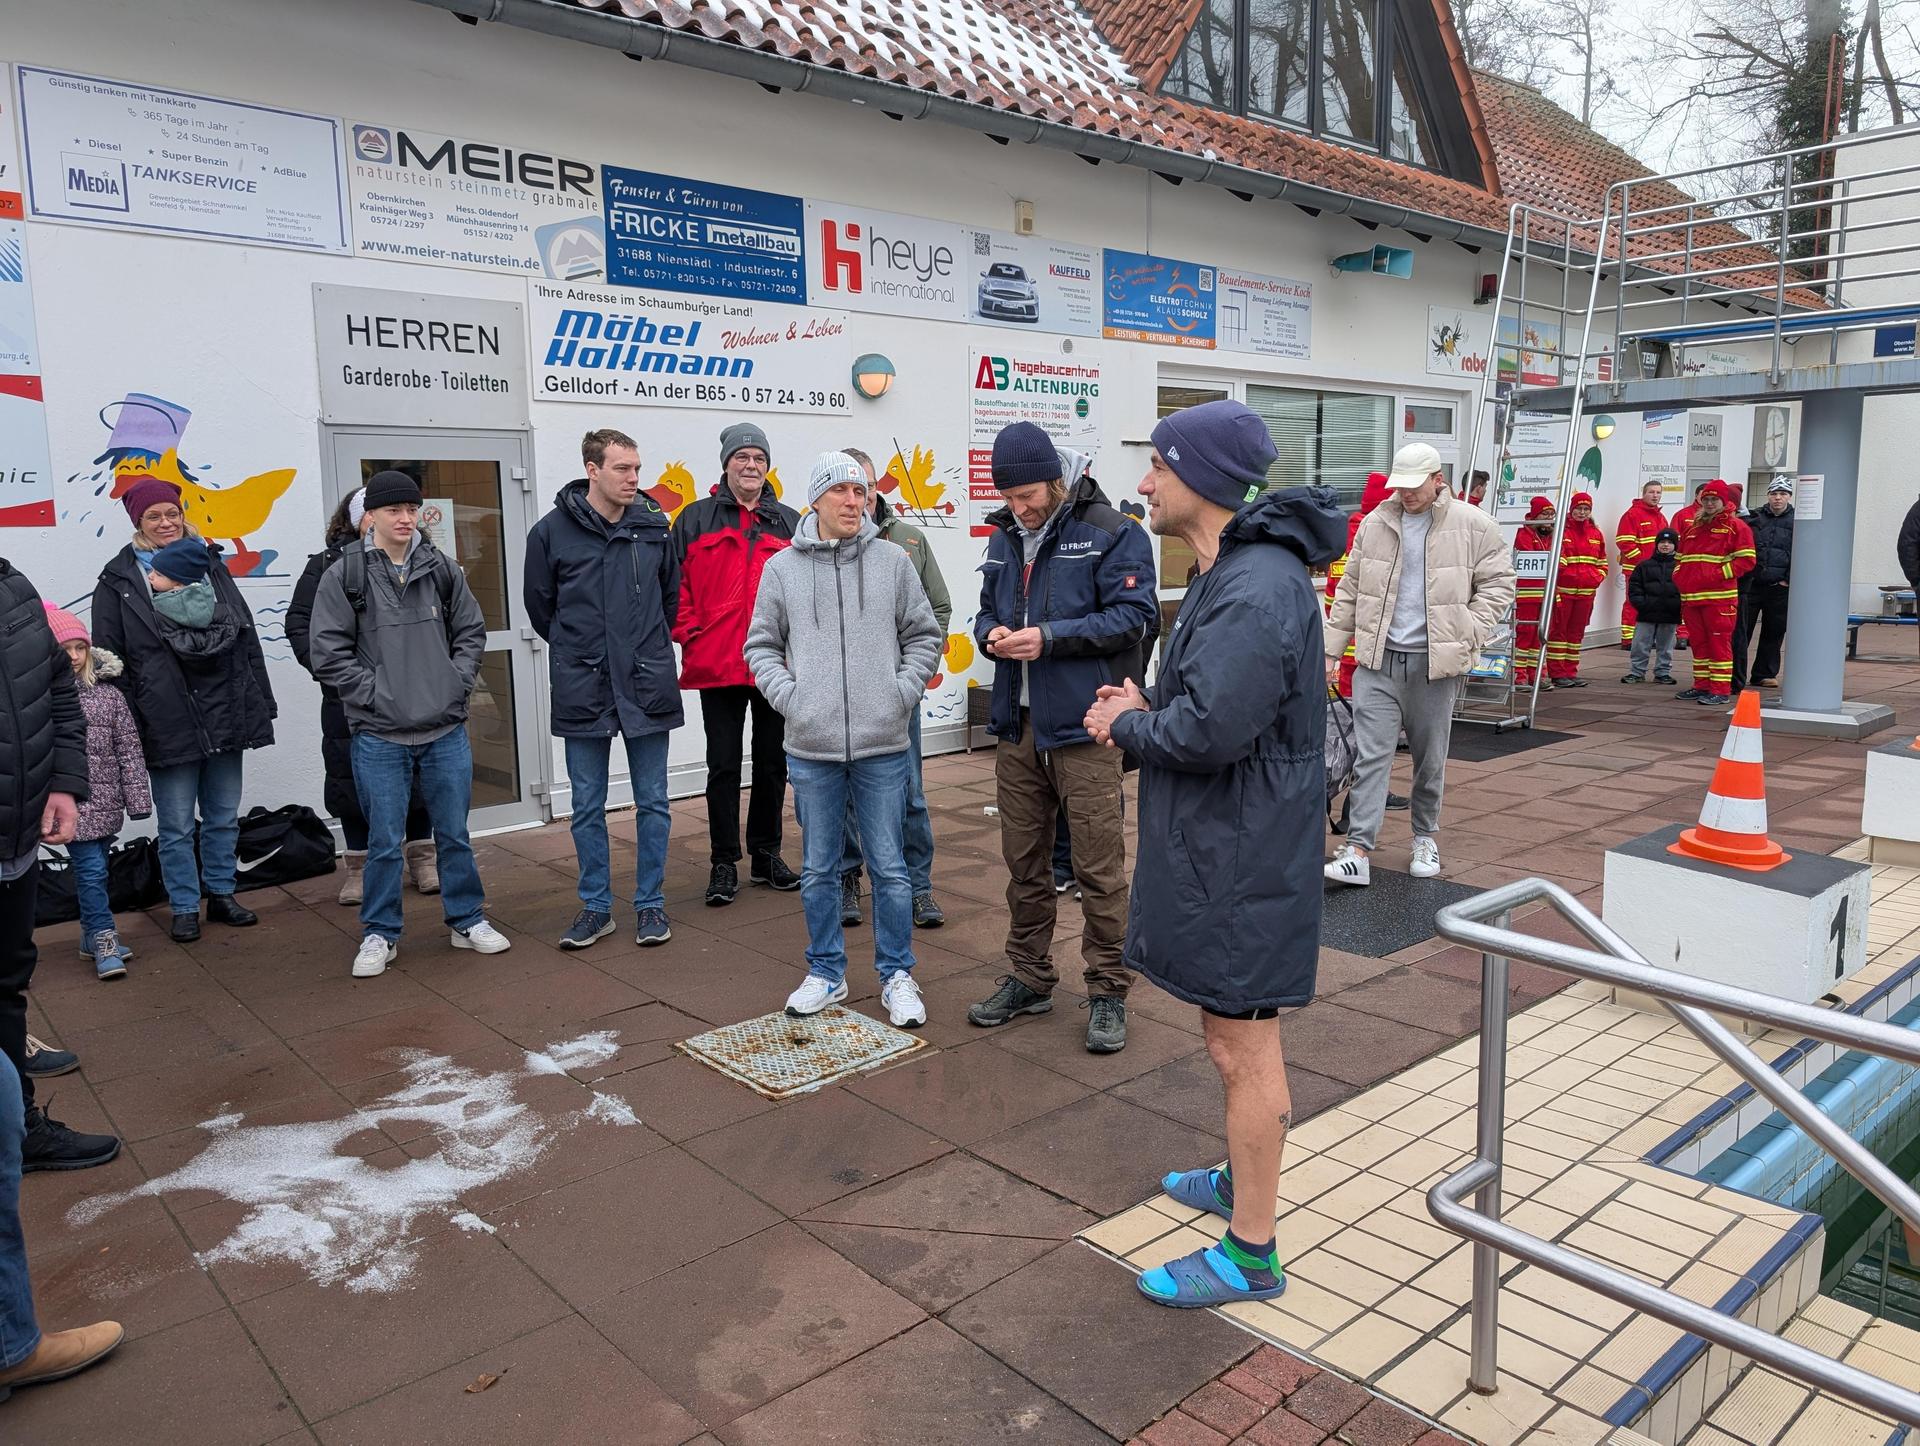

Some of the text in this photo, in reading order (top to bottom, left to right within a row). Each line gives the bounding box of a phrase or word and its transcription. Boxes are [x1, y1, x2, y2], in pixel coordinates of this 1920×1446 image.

[49, 77, 197, 110] Günstig tanken mit Tankkarte
[143, 110, 228, 132] 365 Tage im Jahr
[88, 138, 122, 151] Diesel
[176, 131, 269, 155] 24 Stunden am Tag
[161, 149, 229, 167] Super Benzin
[396, 131, 595, 197] MEIER
[131, 164, 258, 194] TANKSERVICE
[273, 166, 307, 179] AdBlue
[149, 193, 200, 205] Gewerbegebiet
[356, 165, 599, 211] naturstein steinmetz grabmale
[367, 191, 426, 207] Obernkirchen
[609, 178, 661, 200] Fenster
[665, 188, 677, 203] &
[682, 189, 719, 208] Türen
[722, 201, 744, 213] von
[149, 201, 178, 210] Kleefeld
[360, 202, 434, 221] Krainhäger Weg 3
[456, 204, 519, 220] Hess. Oldendorf
[370, 216, 398, 226] 05724
[404, 220, 425, 230] 2297
[446, 214, 529, 232] Münchhausenring 14
[609, 208, 796, 252] FRICKE metallbau
[463, 228, 488, 238] 05152
[494, 232, 514, 242] 4202
[362, 240, 540, 270] www.meier-naturstein.de
[617, 247, 798, 279] 31688 Nienstädt Industriestr. 6
[869, 226, 953, 282] heye
[622, 265, 641, 277] Tel.
[740, 280, 796, 295] 05721-72409
[1049, 263, 1091, 278] KAUFFELD
[870, 276, 955, 303] international
[1218, 272, 1311, 298] Bauelemente-Service Koch
[538, 285, 753, 318] Ihre Adresse im Schaumburger Land!
[1150, 294, 1213, 310] ELEKTROTECHNIK
[346, 313, 500, 356] HERREN
[554, 308, 702, 347] Möbel
[721, 318, 843, 350] Wohnen & Leben
[1114, 329, 1210, 347] LEISTUNG VERTRAUEN SICHERHEIT
[343, 364, 509, 393] Garderobe Toiletten
[1013, 358, 1100, 379] hagebaucentrum
[544, 375, 619, 395] Gelldorf
[634, 380, 658, 398] An
[662, 382, 690, 400] der
[695, 384, 726, 401] B65
[741, 387, 750, 403] 0
[755, 388, 772, 404] 57
[777, 389, 795, 405] 24
[808, 391, 825, 407] 39
[829, 392, 846, 408] 60
[1013, 377, 1100, 397] ALTENBURG
[974, 398, 1019, 409] Baustoffhandel
[1020, 401, 1030, 409] Tel.
[1031, 402, 1047, 410] 05721
[974, 408, 1017, 417] hagebaumarkt
[1021, 410, 1031, 418] Tel.
[1031, 411, 1047, 419] 05721
[1693, 423, 1718, 437] DAMEN
[1830, 894, 1849, 980] 1
